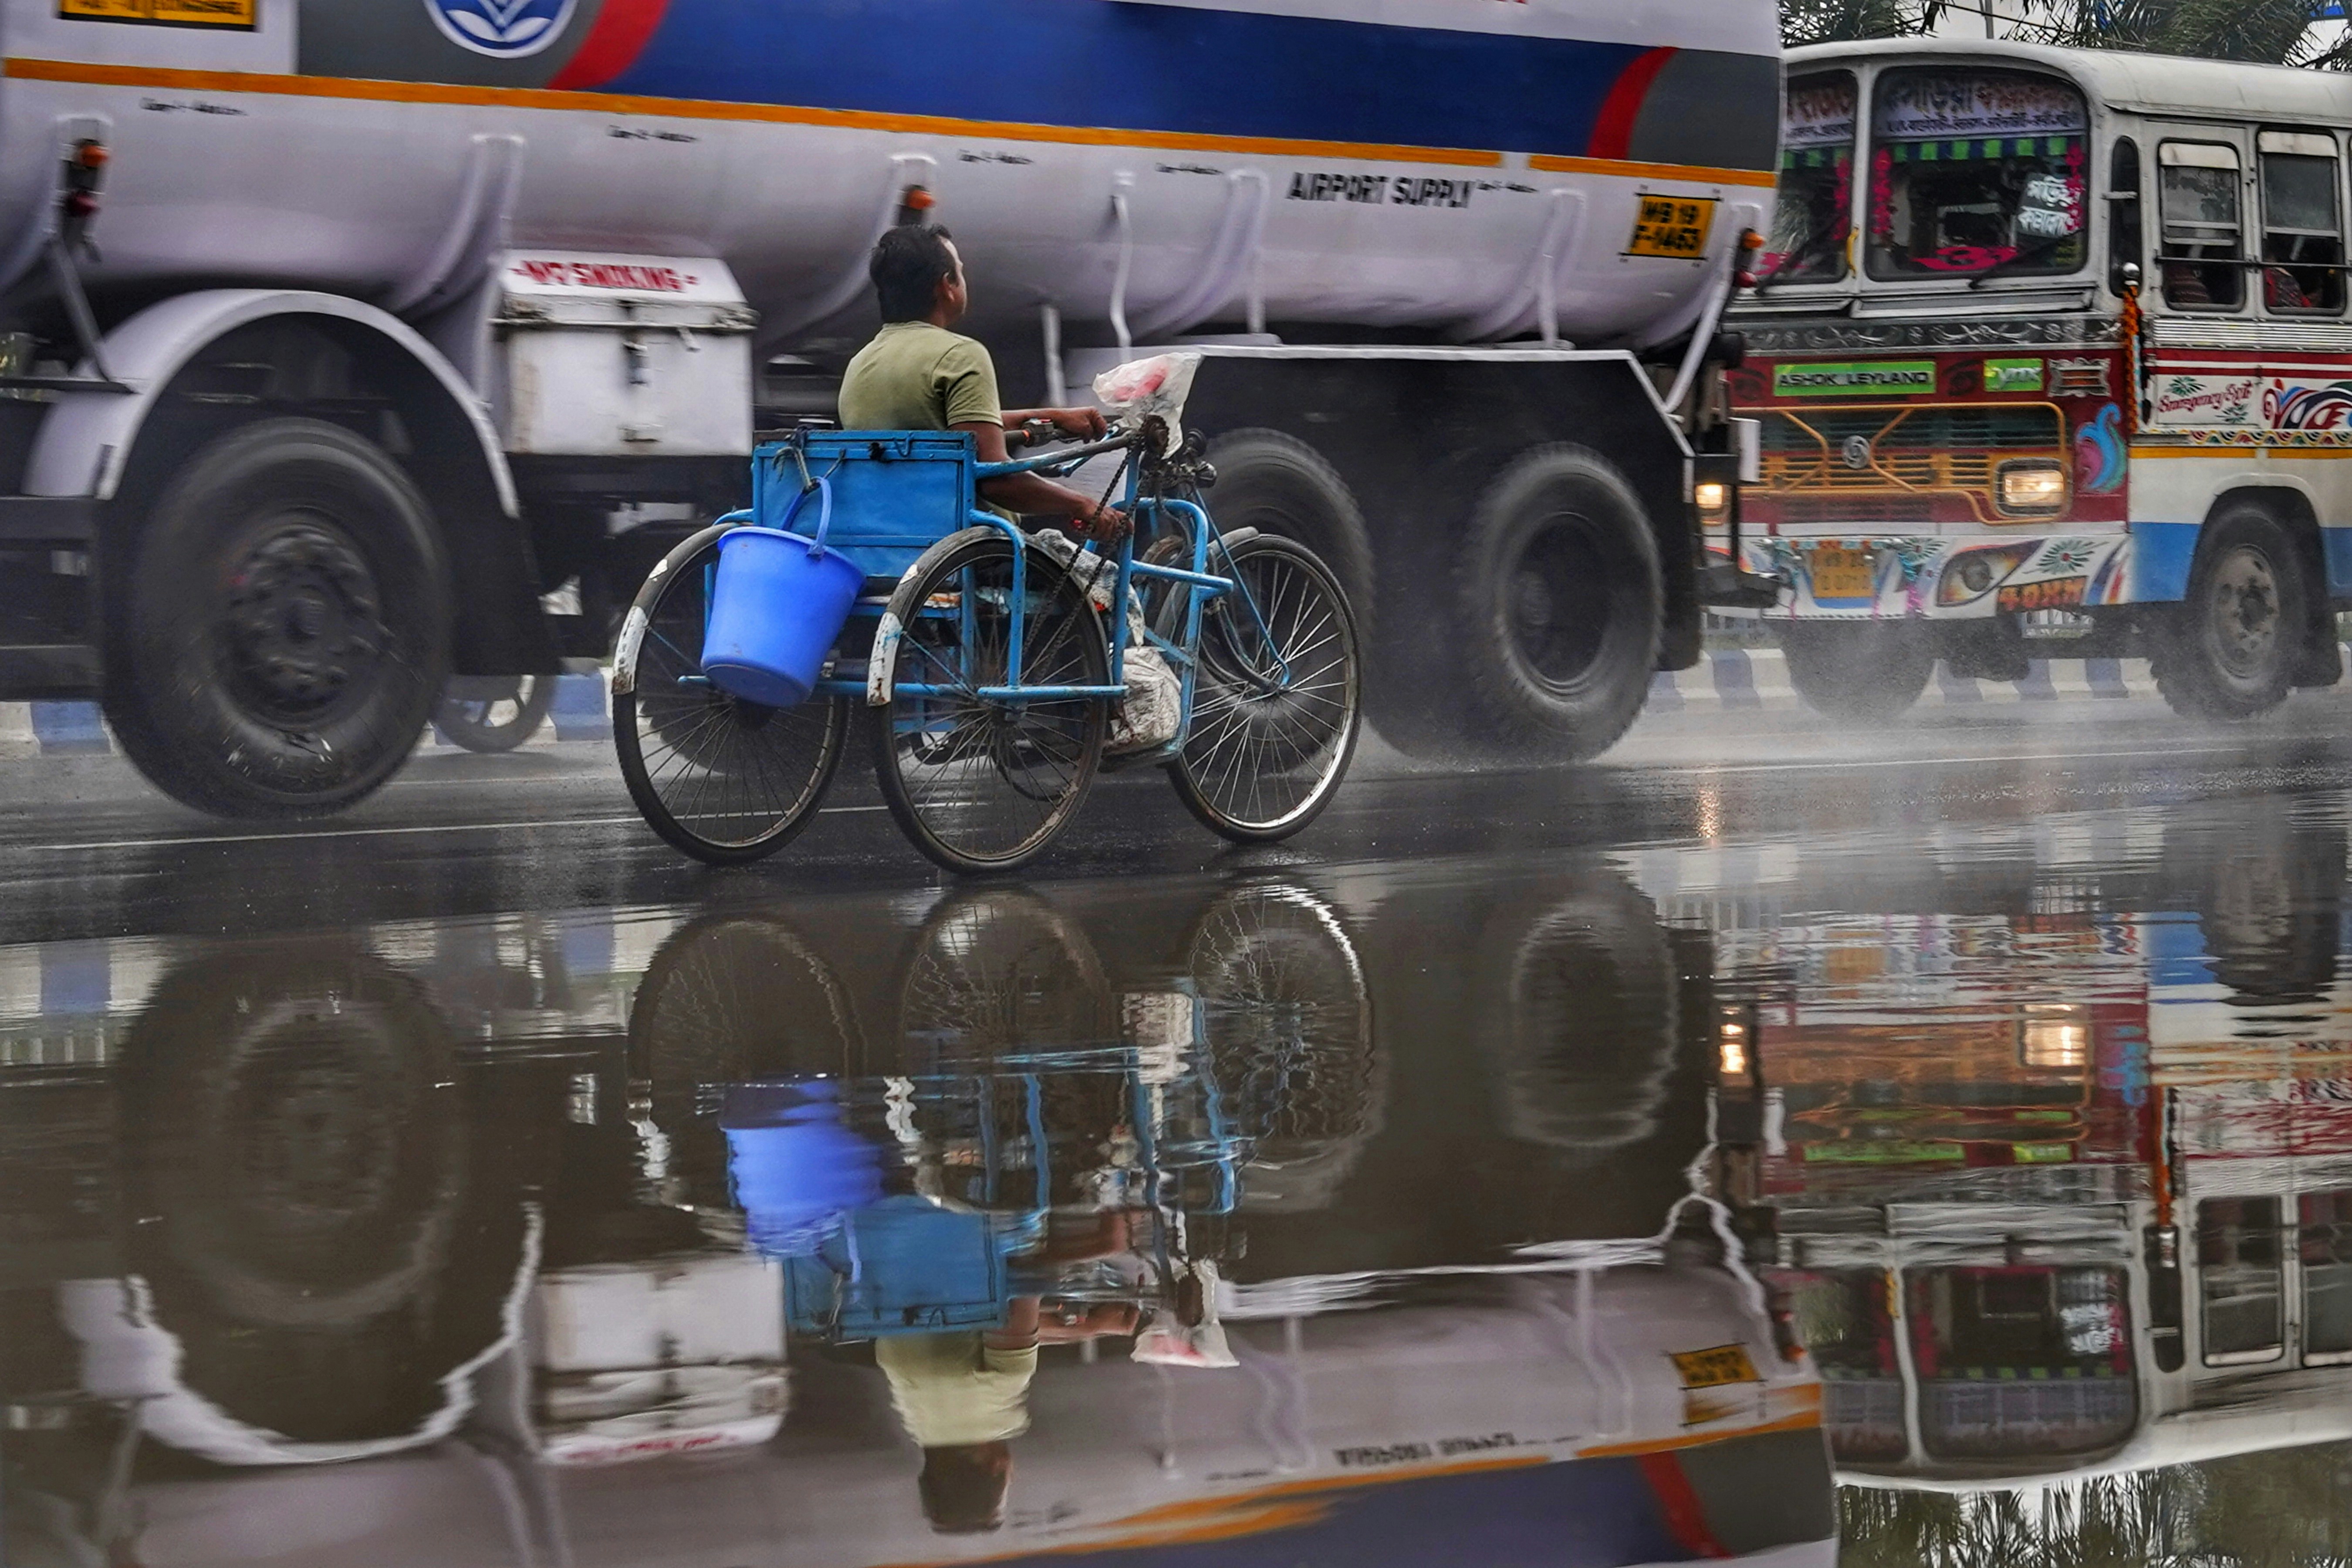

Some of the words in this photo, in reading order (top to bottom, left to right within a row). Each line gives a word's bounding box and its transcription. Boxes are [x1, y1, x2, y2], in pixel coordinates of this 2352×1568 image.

[1286, 172, 1389, 205] AIRPORT
[1392, 175, 1475, 209] SUPPLY
[1778, 373, 1841, 386] ASHOK
[1846, 371, 1931, 385] LEYLAND
